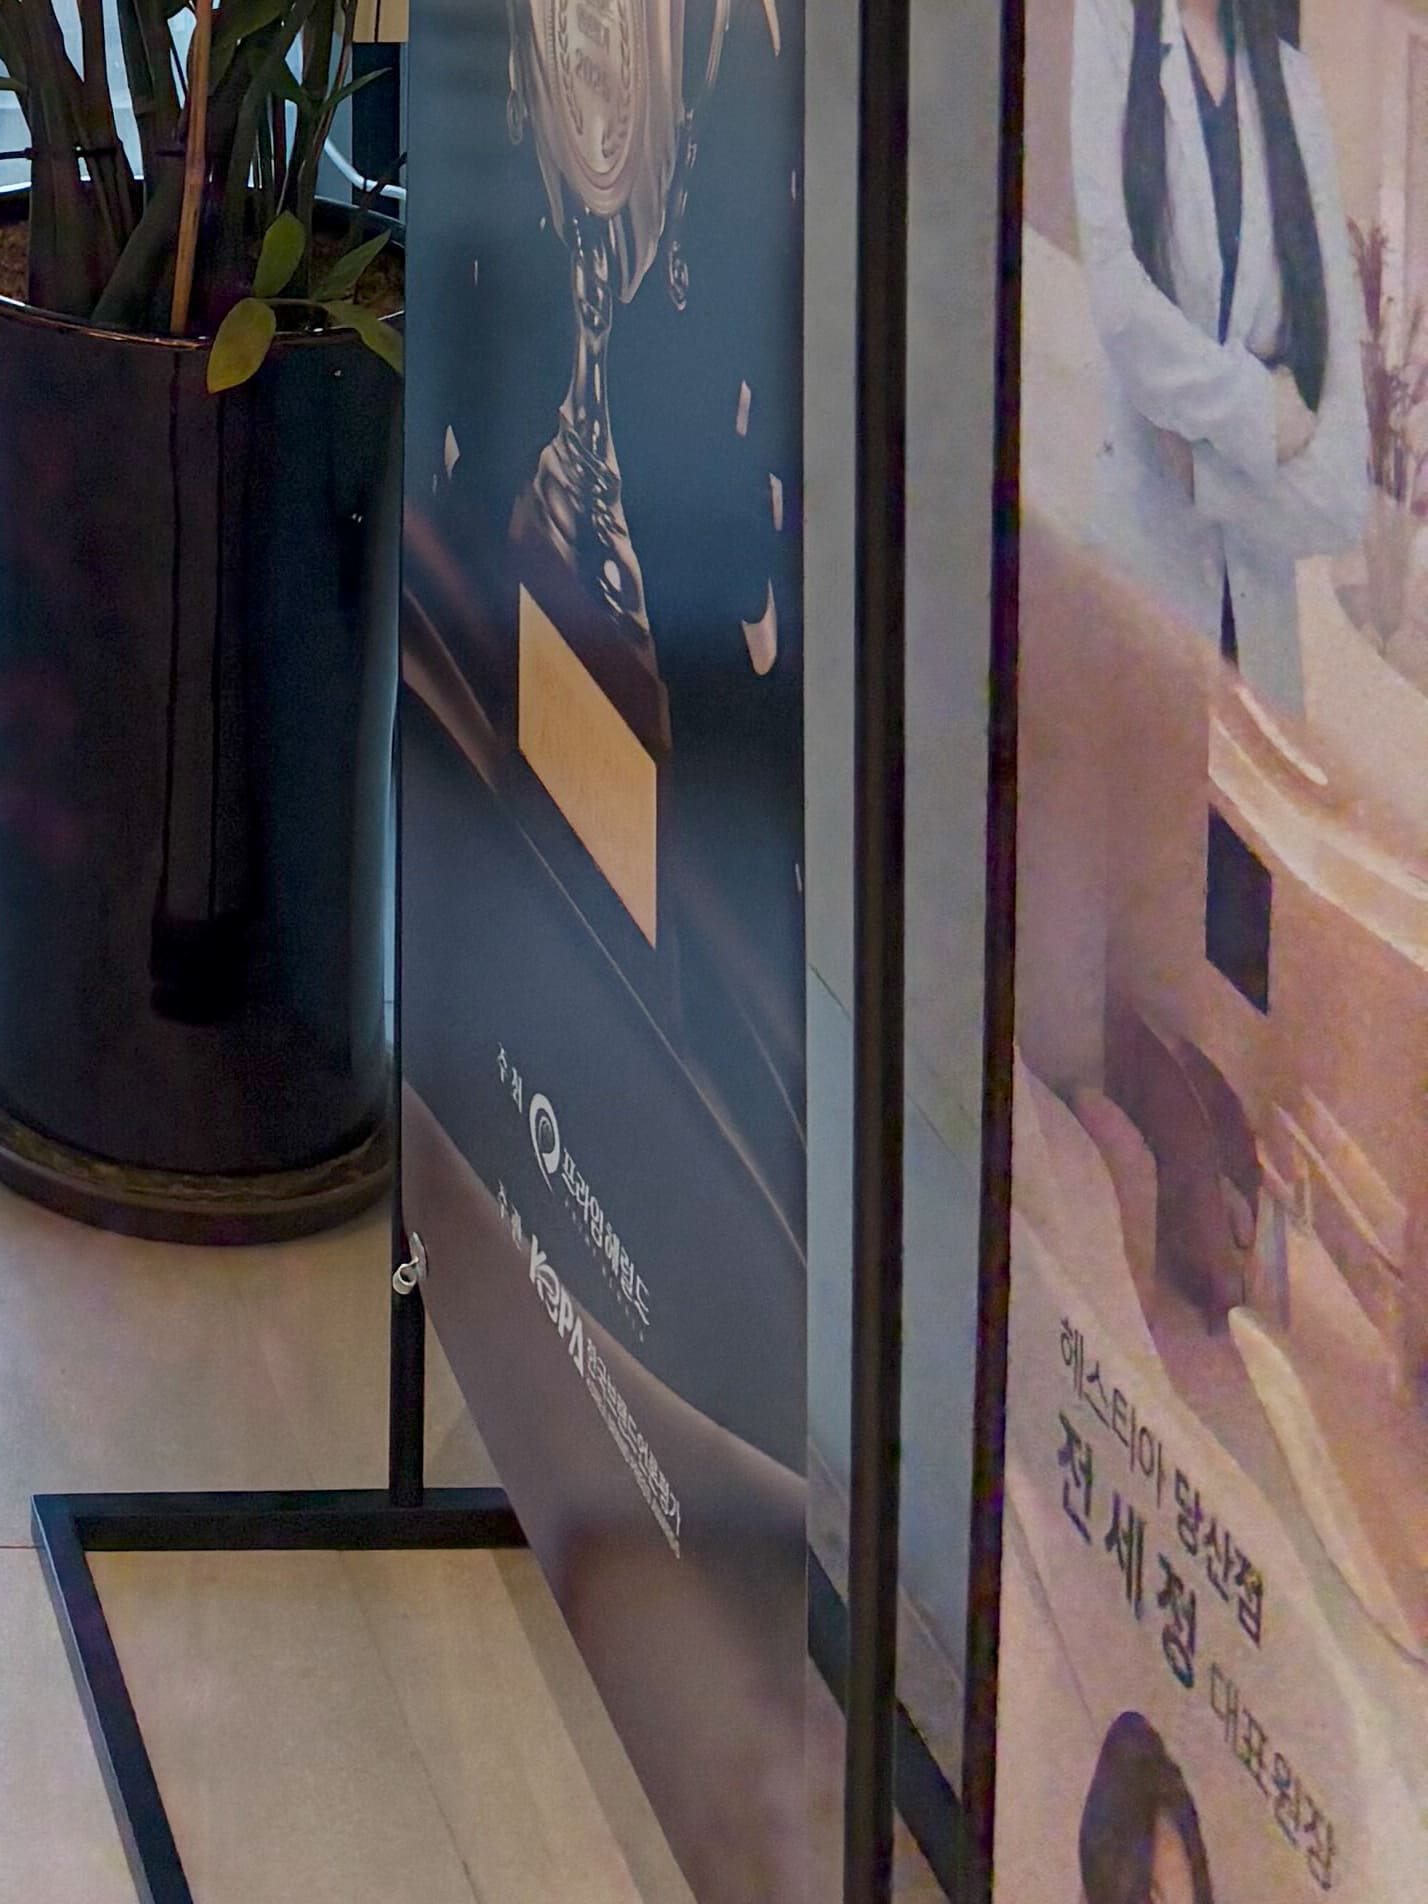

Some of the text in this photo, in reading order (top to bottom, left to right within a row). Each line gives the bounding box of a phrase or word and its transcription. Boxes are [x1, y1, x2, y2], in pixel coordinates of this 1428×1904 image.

[528, 1232, 584, 1378] KOPA
[1059, 1315, 1264, 1650] 헤스티아 당산점
[1209, 1661, 1335, 1893] 대표원장
